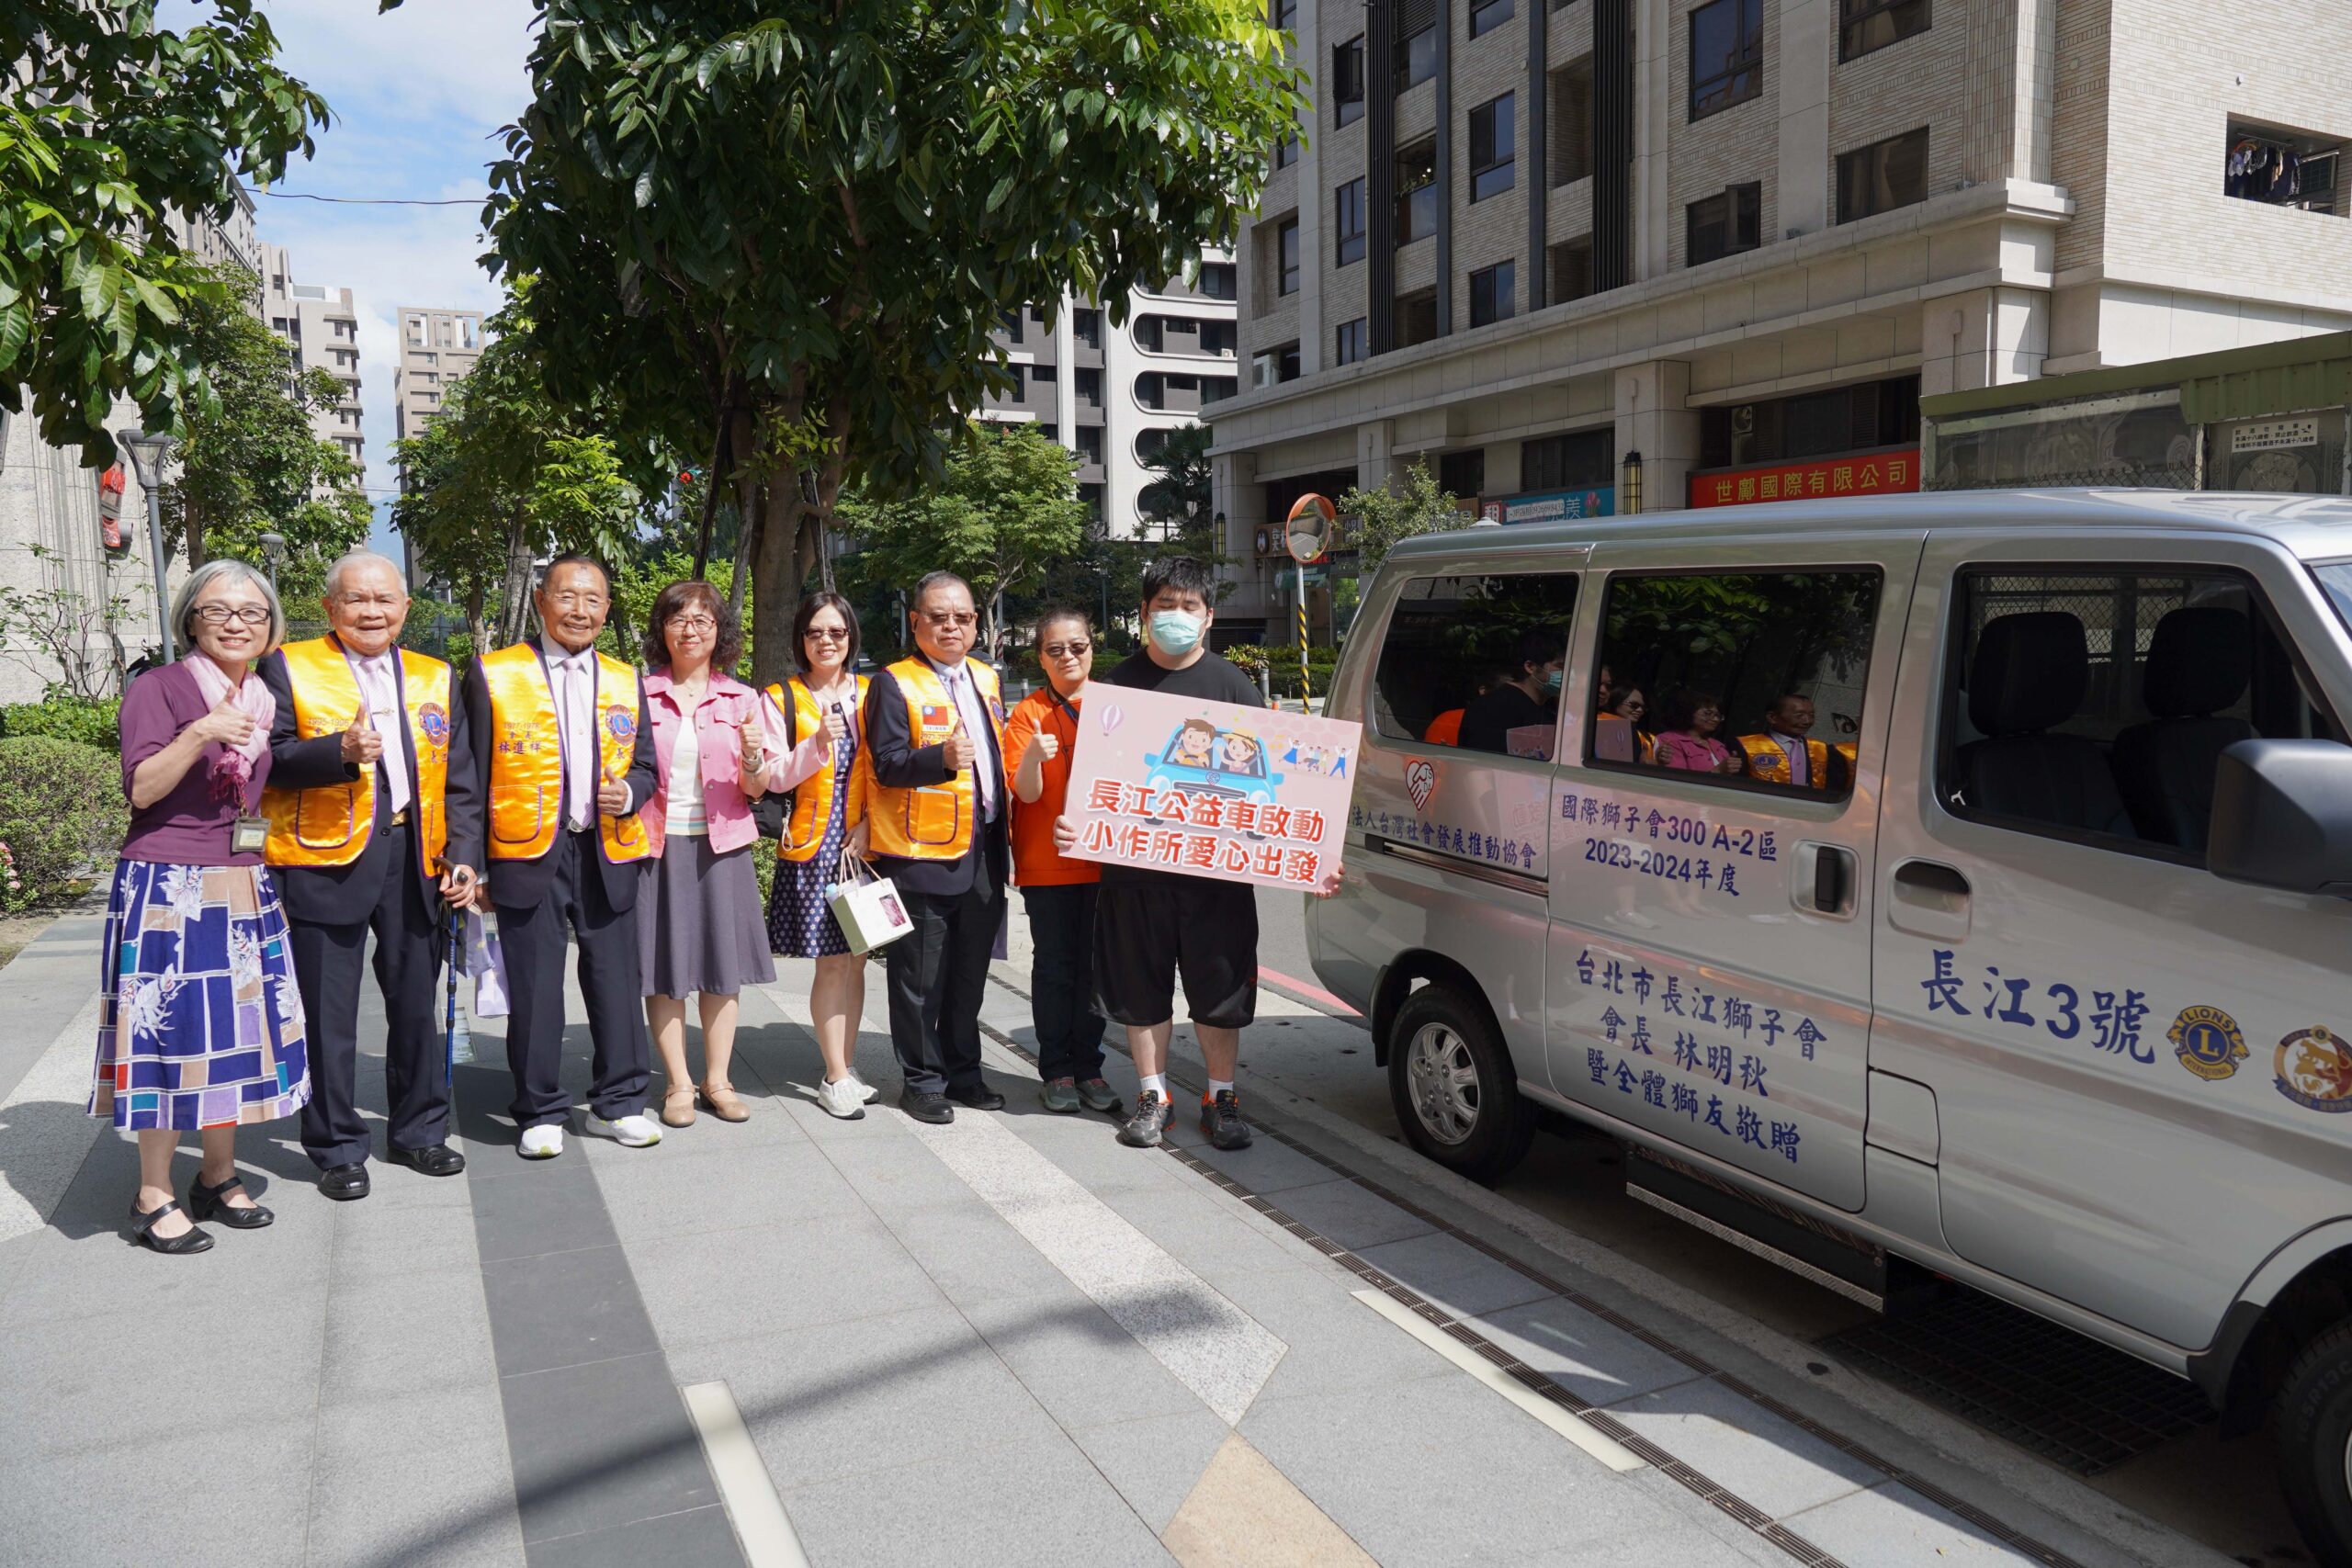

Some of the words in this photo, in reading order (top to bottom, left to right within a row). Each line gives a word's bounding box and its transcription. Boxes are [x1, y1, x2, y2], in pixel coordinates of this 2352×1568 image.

[1088, 779, 1325, 842] 長江公益車啟動
[1348, 805, 1537, 871] 法人台灣社會發展推動協會
[1082, 820, 1319, 884] 小作所愛心出發
[1585, 838, 1740, 897] 2023-2024年度
[1576, 950, 1826, 1061] 台北市長江獅子會
[1920, 948, 2156, 1065] 長江3號
[2185, 1008, 2233, 1030] LIONS
[1600, 1006, 1654, 1055] 會長
[1674, 1031, 1769, 1098] 林明秋
[2198, 1028, 2220, 1057] L
[1588, 1047, 1801, 1164] 暨全體獅友敬贈
